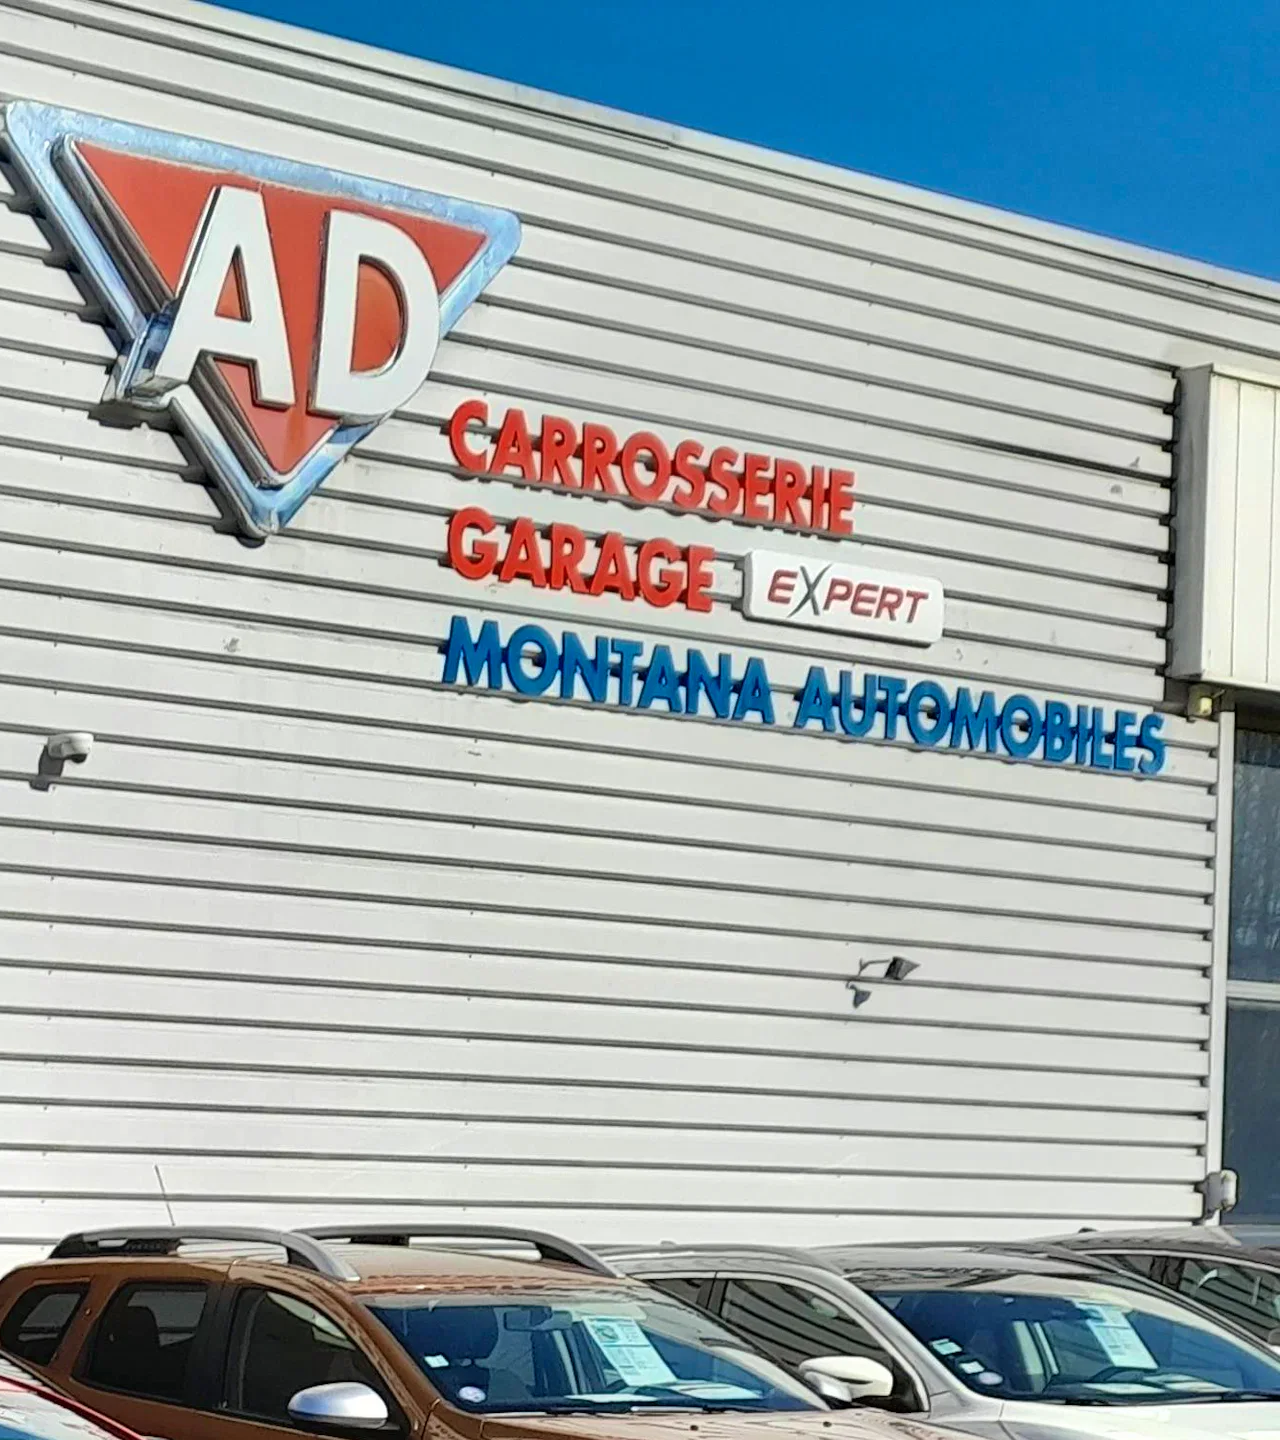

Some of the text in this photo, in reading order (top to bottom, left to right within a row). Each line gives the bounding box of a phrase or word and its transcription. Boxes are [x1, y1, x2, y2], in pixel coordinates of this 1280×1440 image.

[153, 185, 441, 416] AD
[447, 400, 855, 536] CARROSSERIE
[447, 507, 715, 613] GARAGE
[766, 563, 929, 623] EXPERT
[441, 616, 1166, 775] MONTANA AUTOMOBILES
